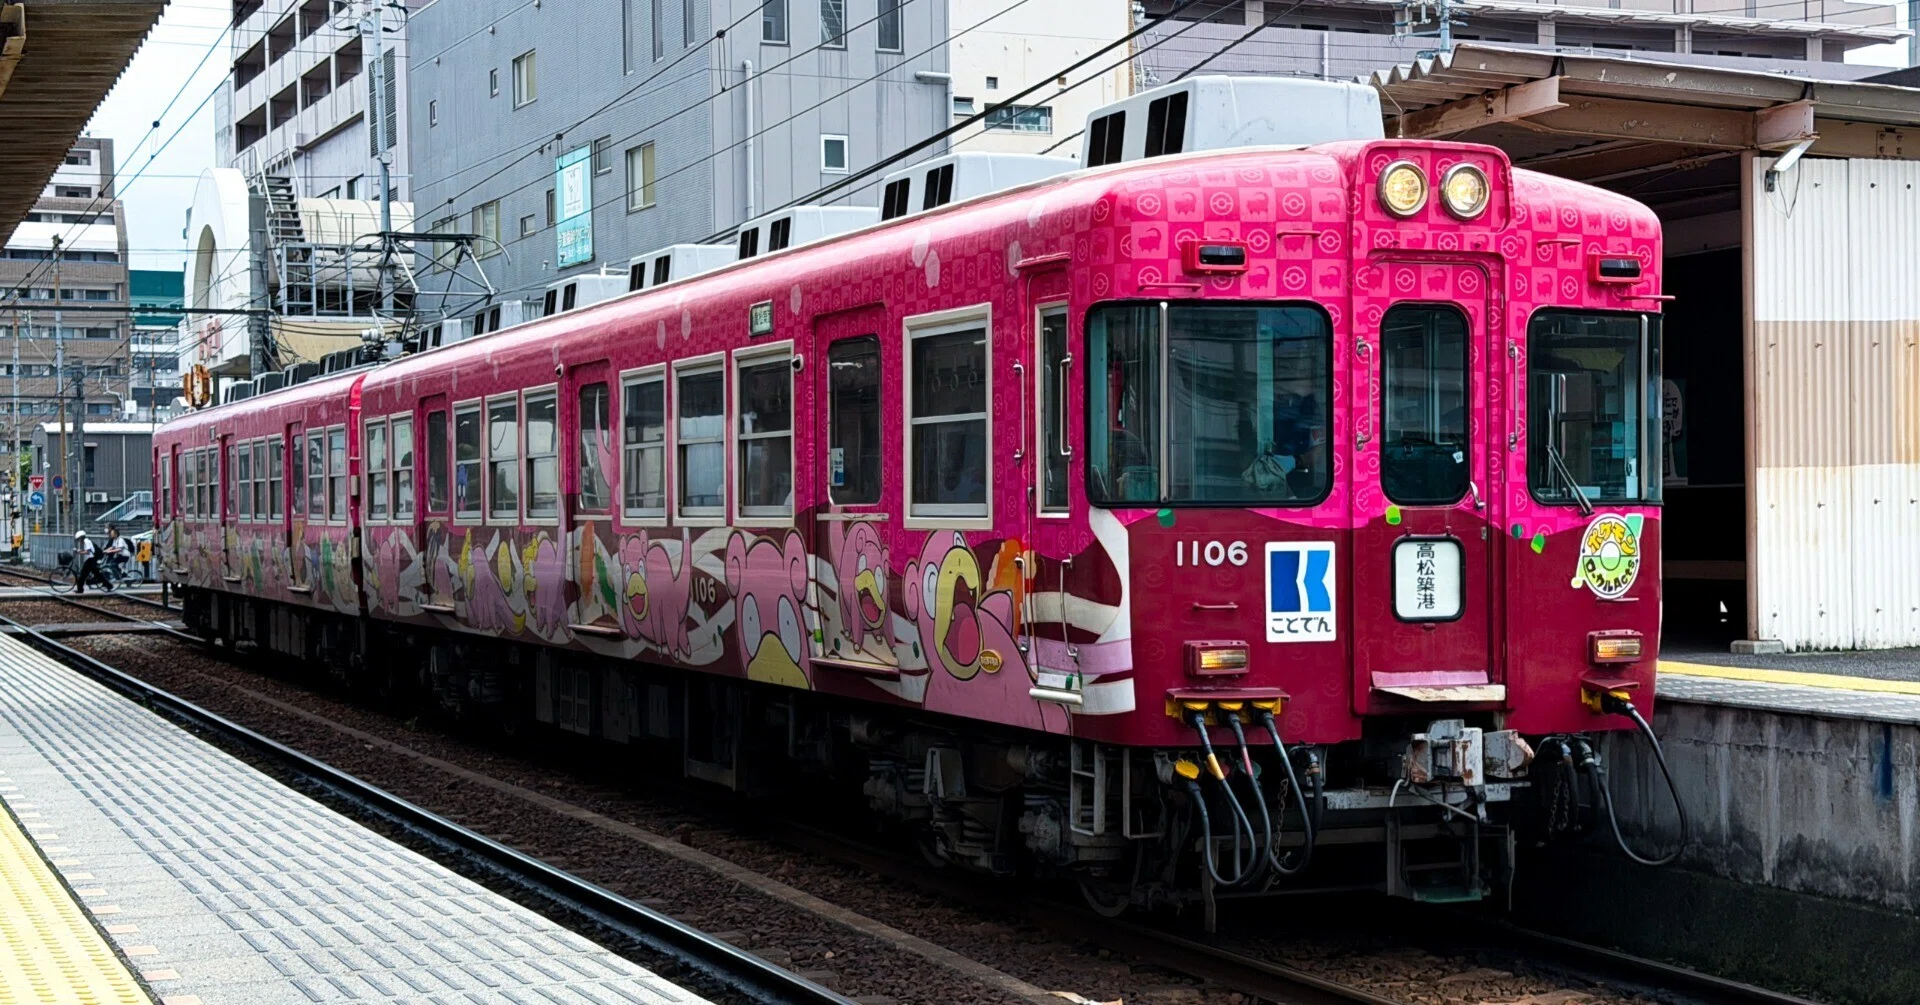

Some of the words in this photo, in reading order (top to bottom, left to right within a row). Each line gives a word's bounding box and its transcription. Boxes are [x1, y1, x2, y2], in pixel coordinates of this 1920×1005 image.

[1587, 521, 1636, 555] ポケモン
[1177, 540, 1249, 567] 1106
[1416, 543, 1436, 610] 高松築港
[1271, 617, 1332, 634] ことでん
